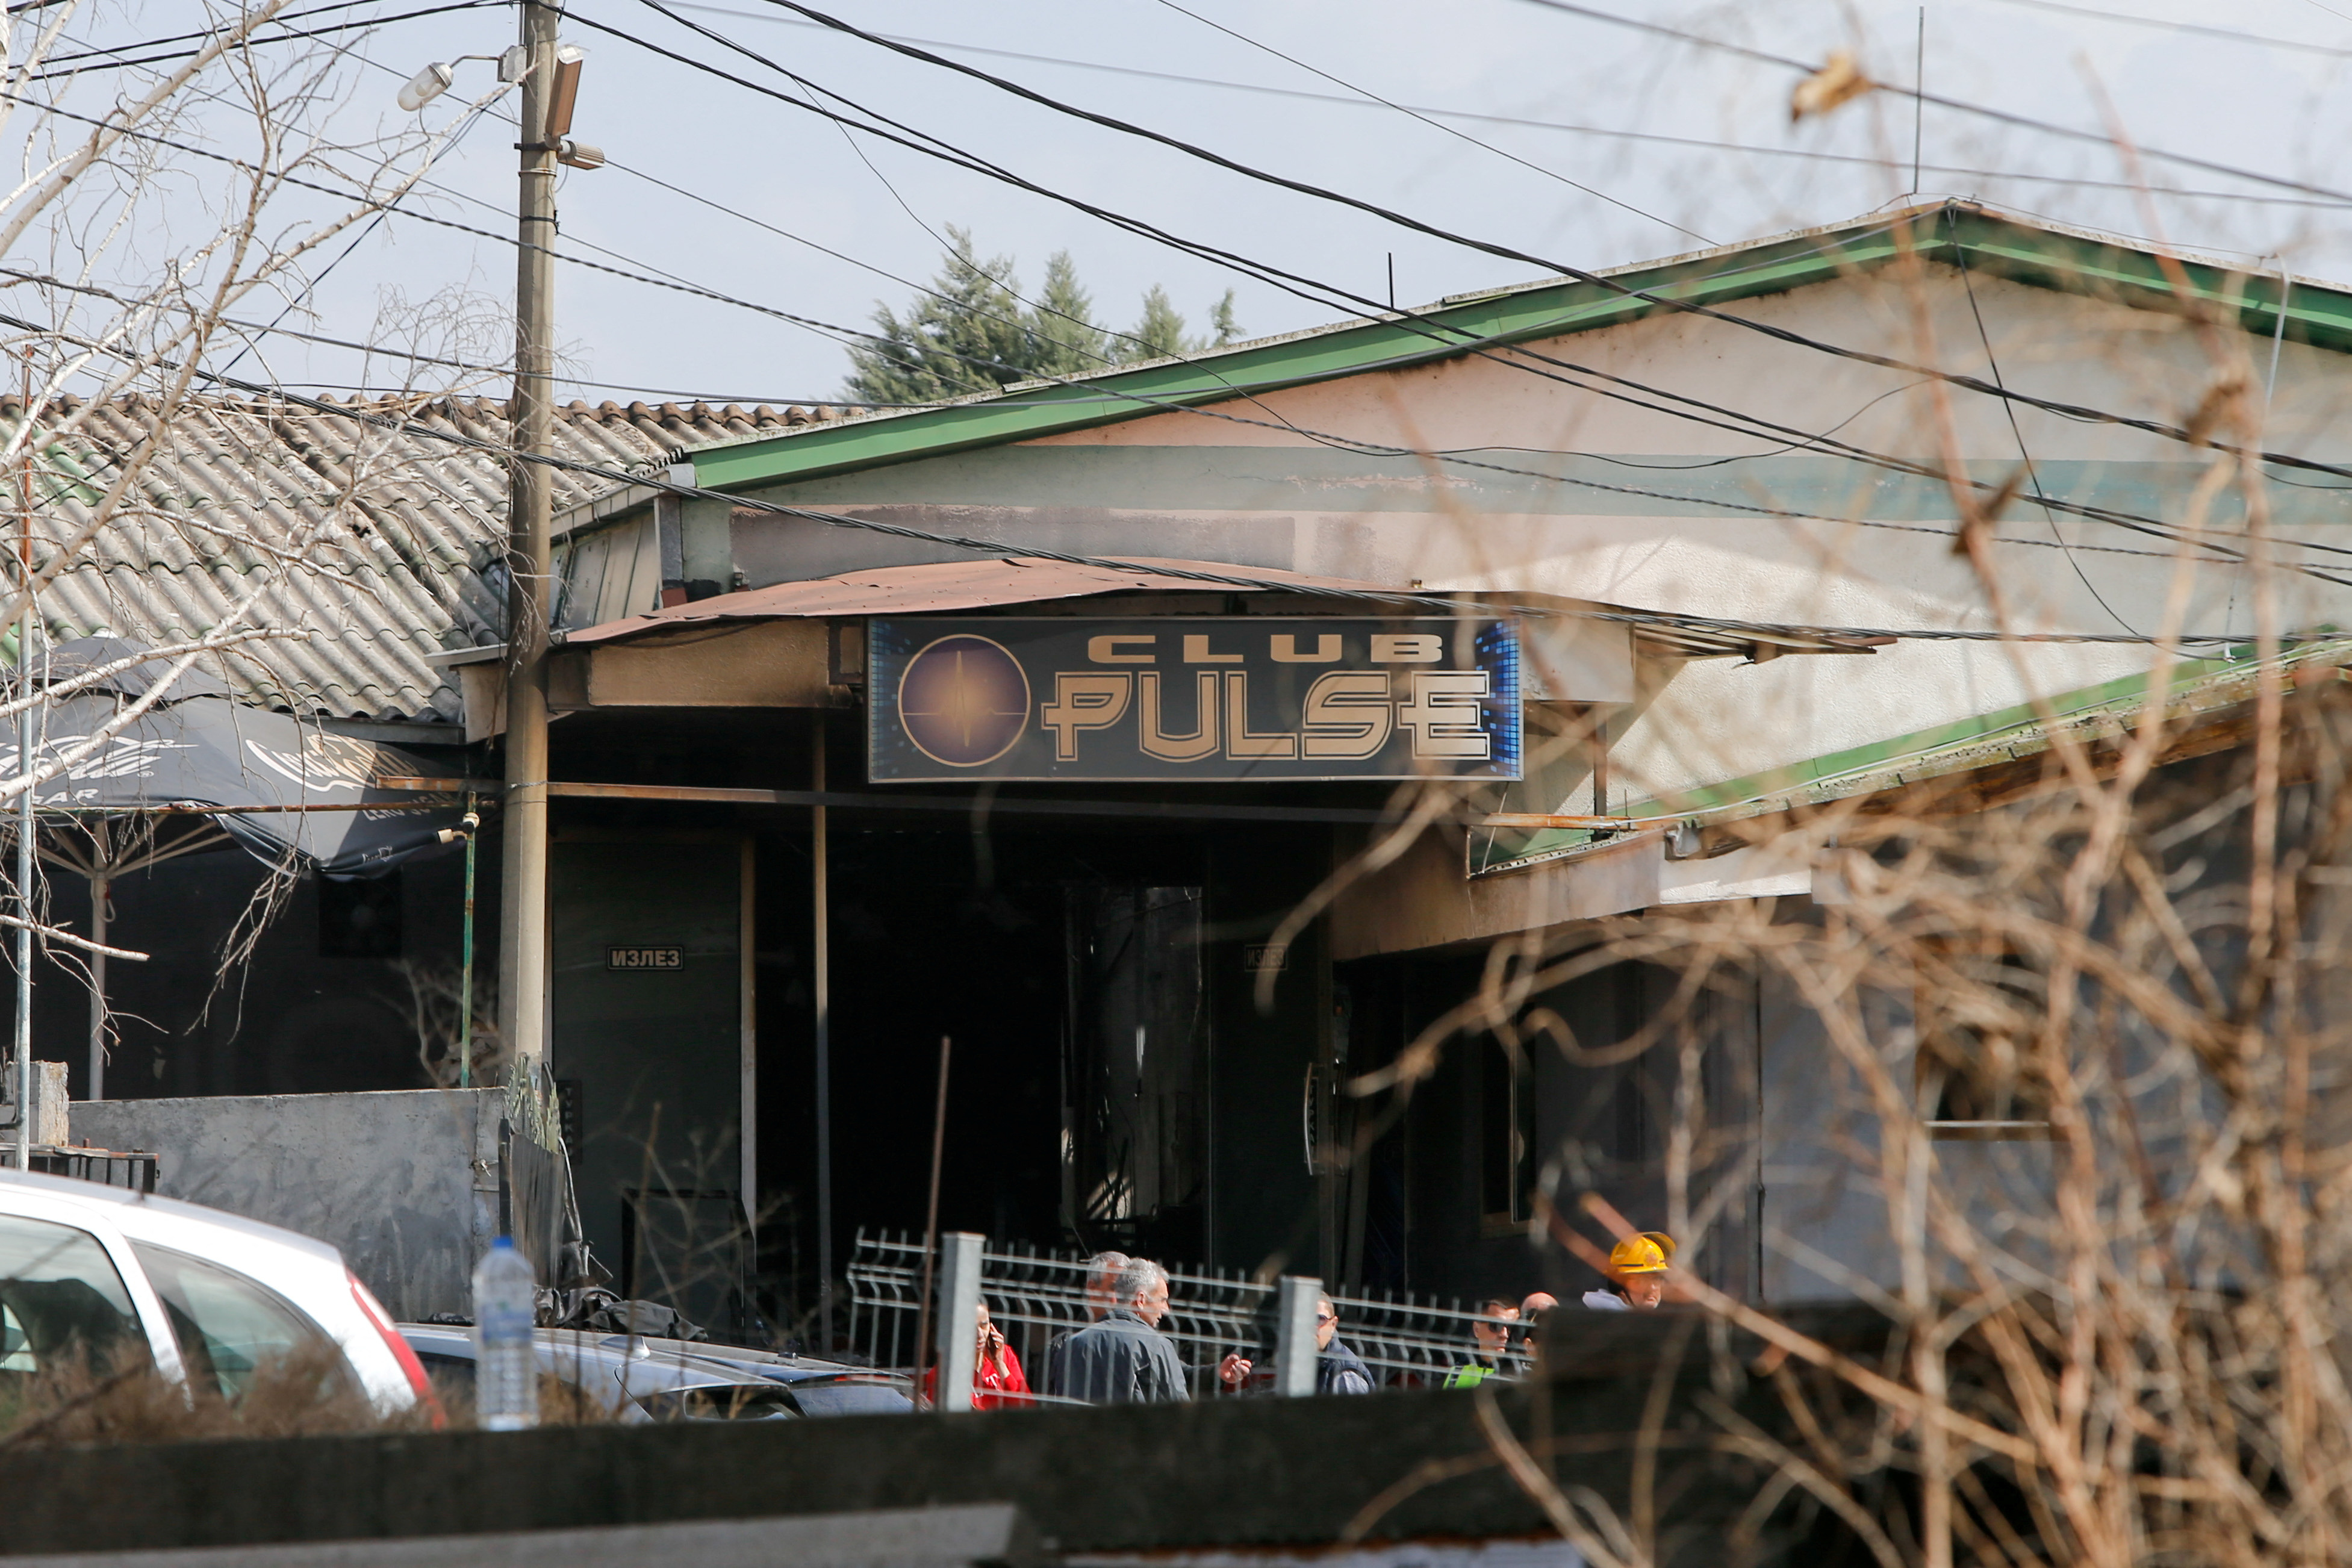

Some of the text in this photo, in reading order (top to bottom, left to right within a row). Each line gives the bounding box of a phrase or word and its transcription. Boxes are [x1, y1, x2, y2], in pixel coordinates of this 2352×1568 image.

[1087, 635, 1443, 664] CLUB
[1041, 670, 1491, 762] PULSE
[611, 950, 680, 967] ИЗЛЕЗ
